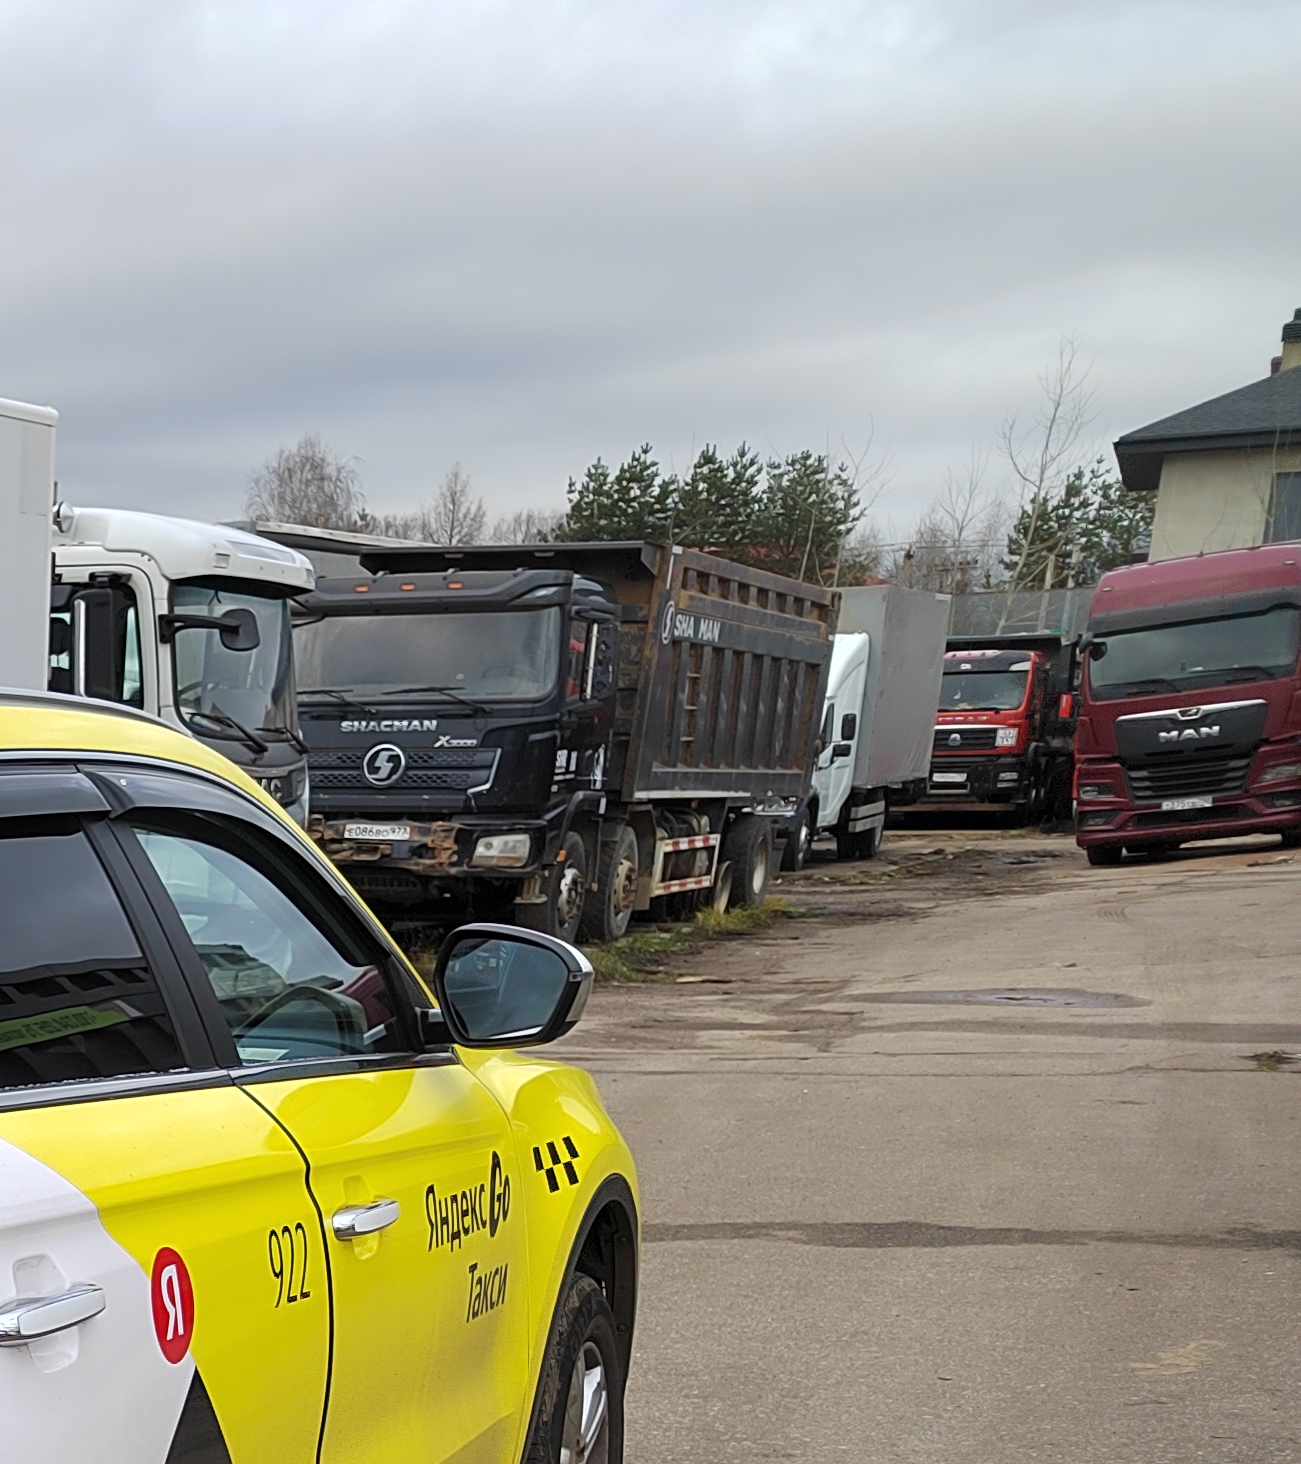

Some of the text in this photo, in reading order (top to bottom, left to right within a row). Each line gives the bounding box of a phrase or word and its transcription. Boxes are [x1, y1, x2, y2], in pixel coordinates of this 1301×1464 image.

[340, 719, 437, 732] SHACMAN
[1159, 725, 1220, 742] MAN
[424, 1150, 510, 1252] Яндекс Go
[268, 1222, 311, 1308] 922
[466, 1262, 508, 1323] Такси
[160, 1263, 185, 1341] Я
